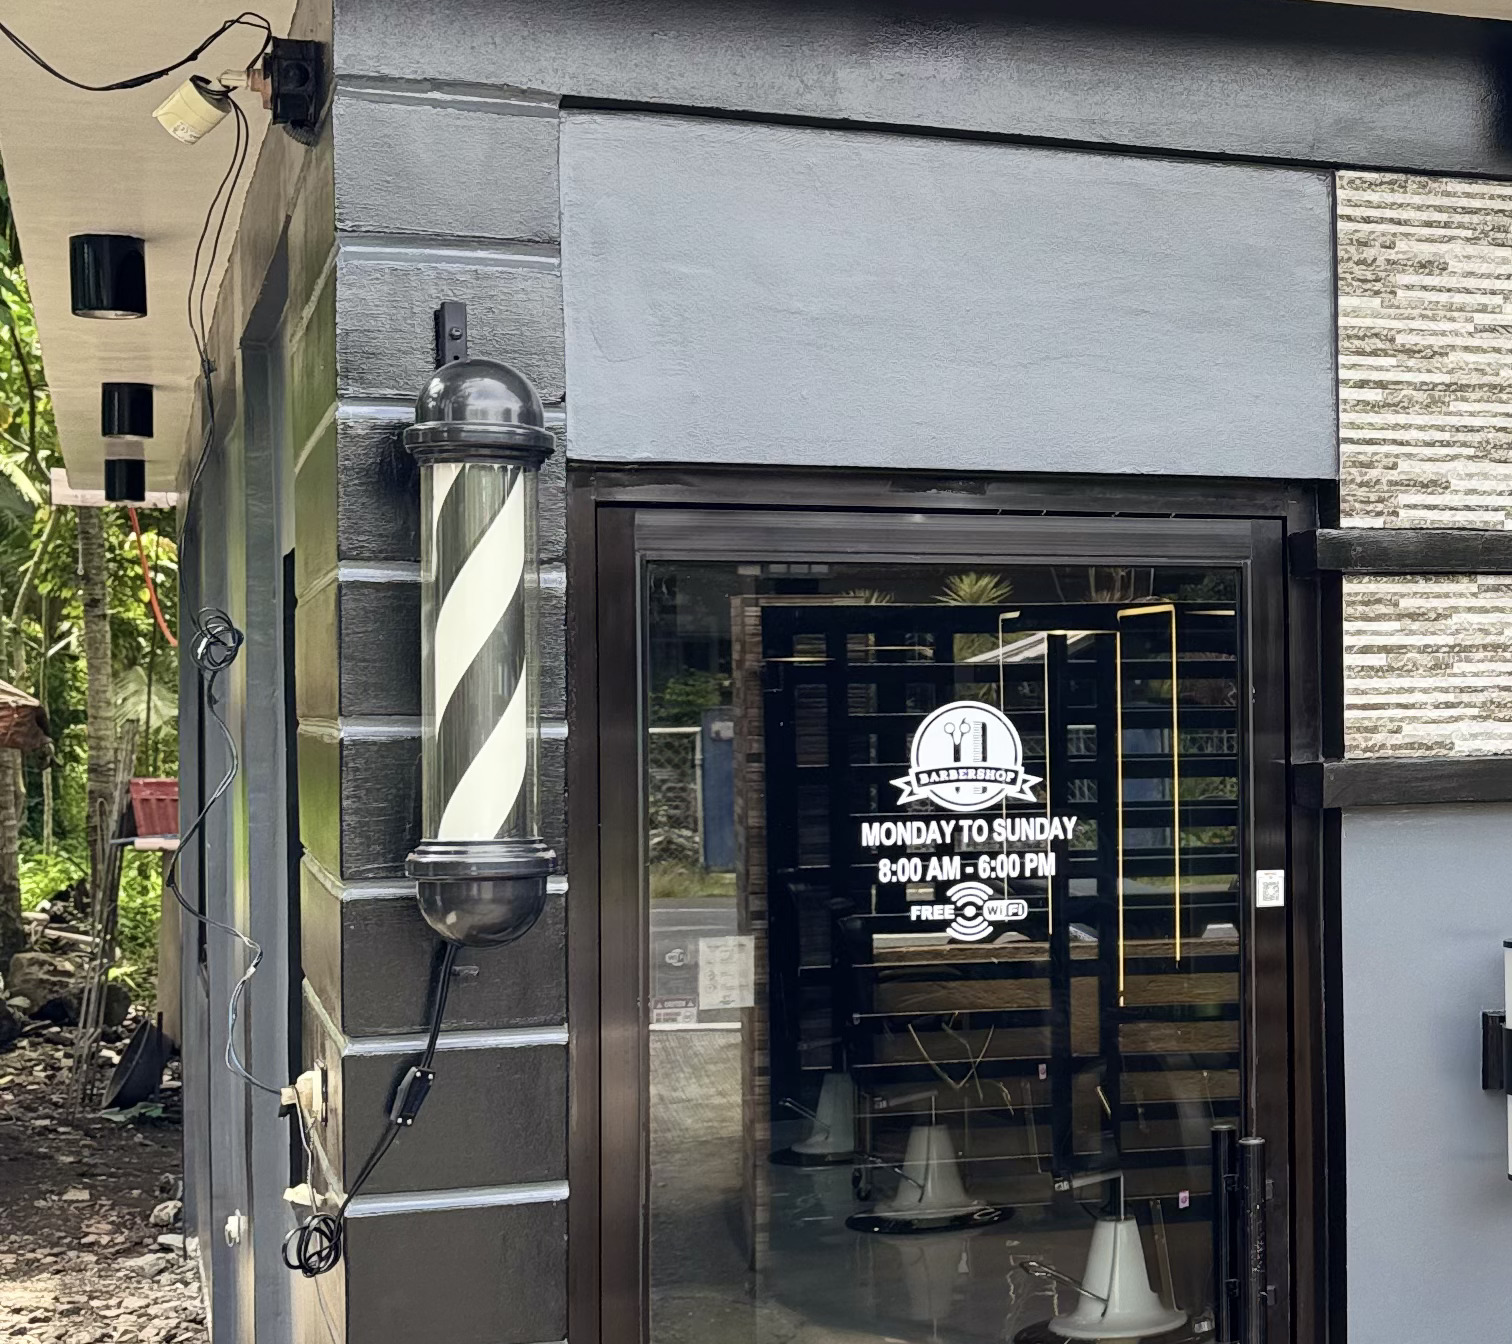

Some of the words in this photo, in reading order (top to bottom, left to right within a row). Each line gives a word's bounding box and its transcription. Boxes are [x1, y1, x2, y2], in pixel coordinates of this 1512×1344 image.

[919, 769, 1015, 784] BARBERSHOP
[861, 820, 956, 846] MONDAY
[959, 819, 989, 842] TO
[993, 816, 1077, 841] SUNDAY
[878, 858, 922, 883] 8:00
[926, 856, 960, 880] AM
[978, 855, 1020, 878] 6:00
[1024, 853, 1055, 876] PM
[911, 905, 955, 920] FREE
